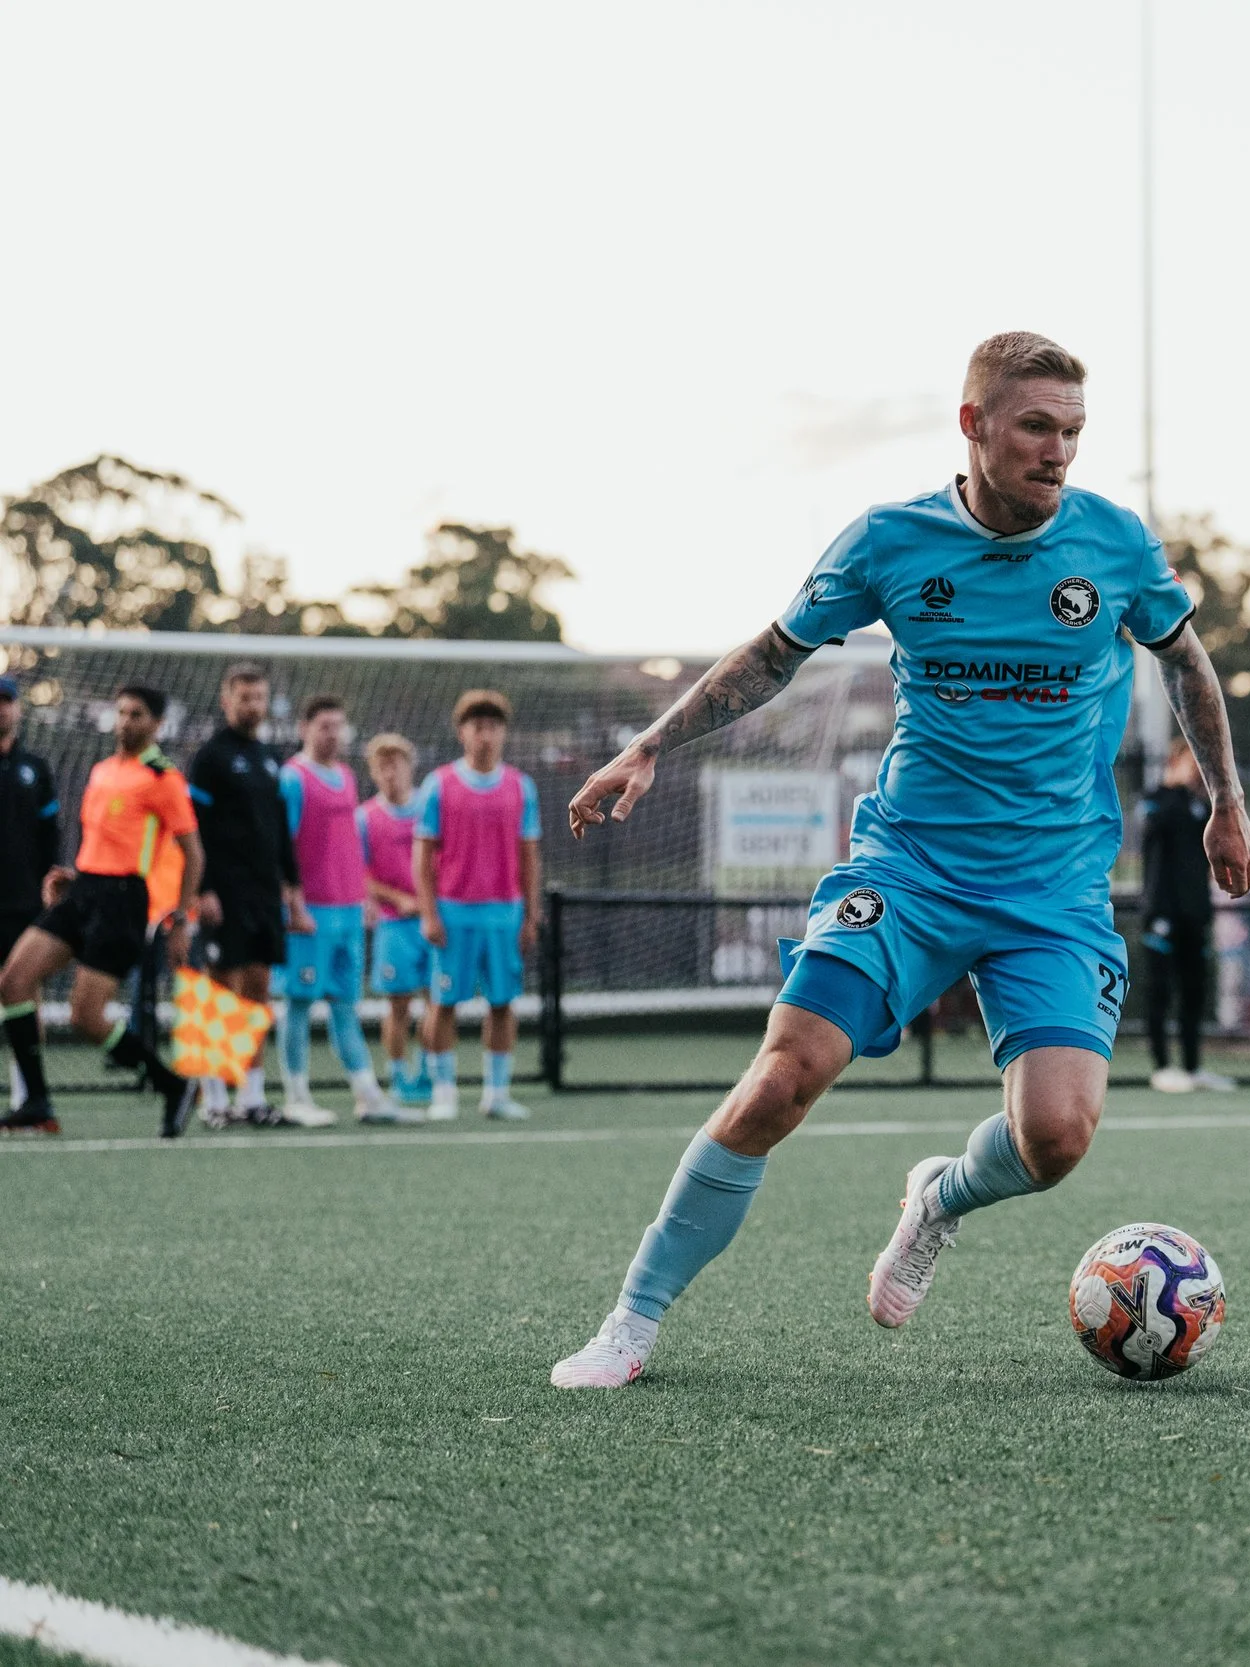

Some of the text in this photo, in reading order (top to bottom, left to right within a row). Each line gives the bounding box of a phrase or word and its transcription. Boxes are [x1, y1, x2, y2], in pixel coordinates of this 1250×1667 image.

[981, 553, 1033, 562] DEPLOY
[1057, 578, 1095, 593] SUTHERLAND
[1057, 614, 1083, 626] SHARKS
[924, 661, 1082, 682] DOMINELLI
[980, 686, 1069, 703] GWM
[846, 890, 882, 904] SUTHERLAND
